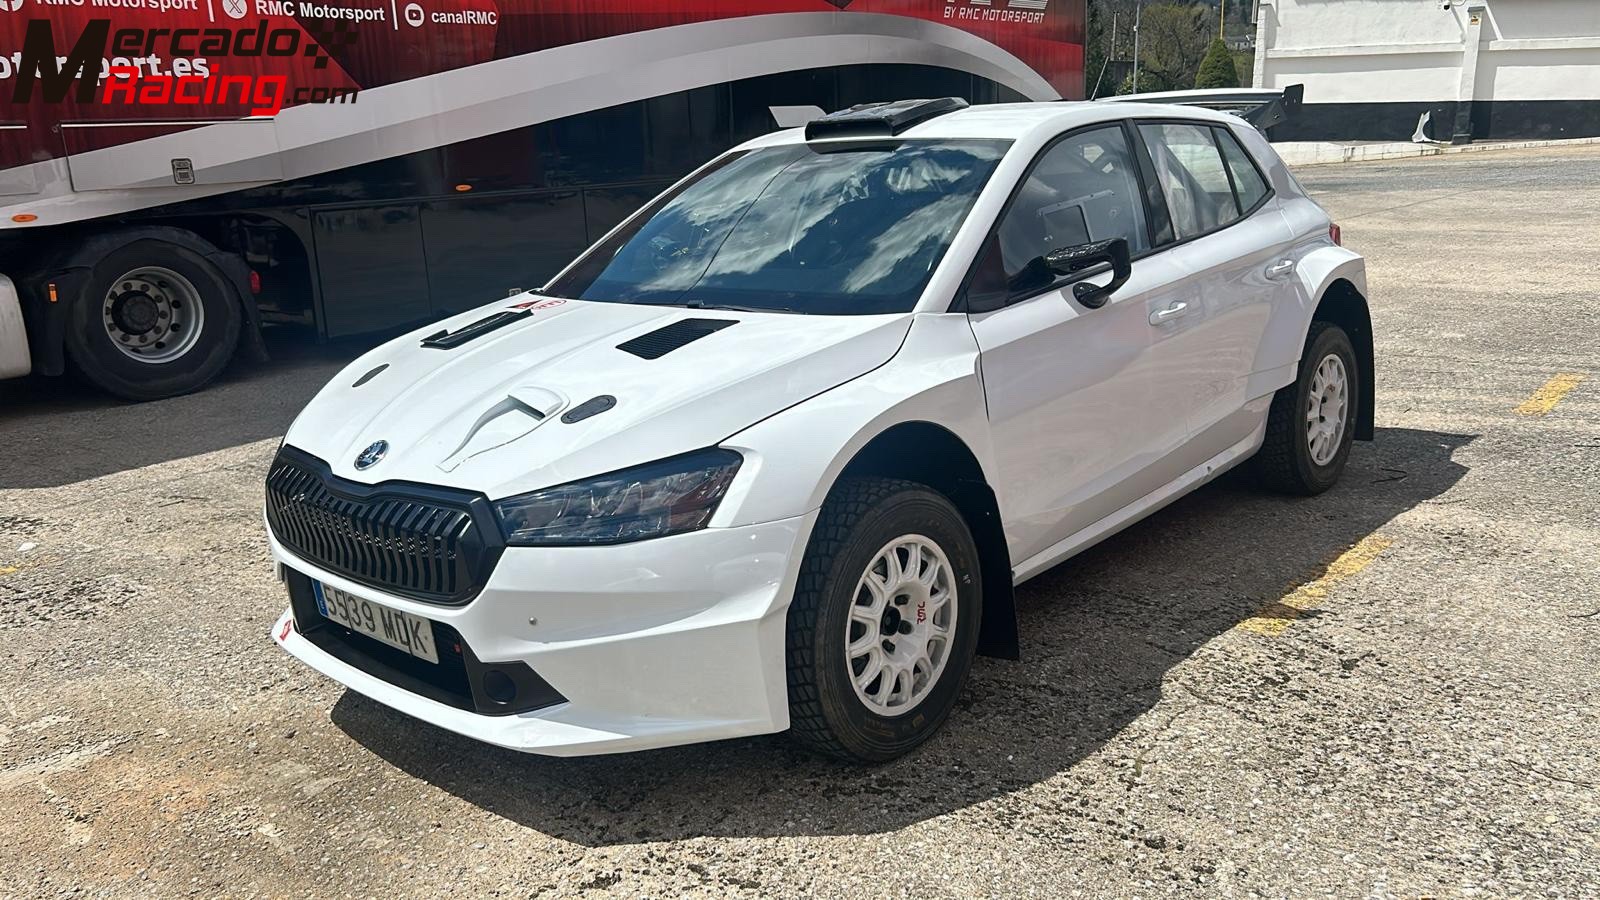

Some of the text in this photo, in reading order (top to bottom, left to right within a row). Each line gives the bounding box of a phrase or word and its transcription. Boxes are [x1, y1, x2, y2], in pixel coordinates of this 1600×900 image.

[255, 0, 386, 23] RMC Motorsport
[431, 10, 497, 25] canalRMC
[943, 6, 1045, 23] BY RMC MOTORSPORT
[379, 607, 428, 654] MDK
